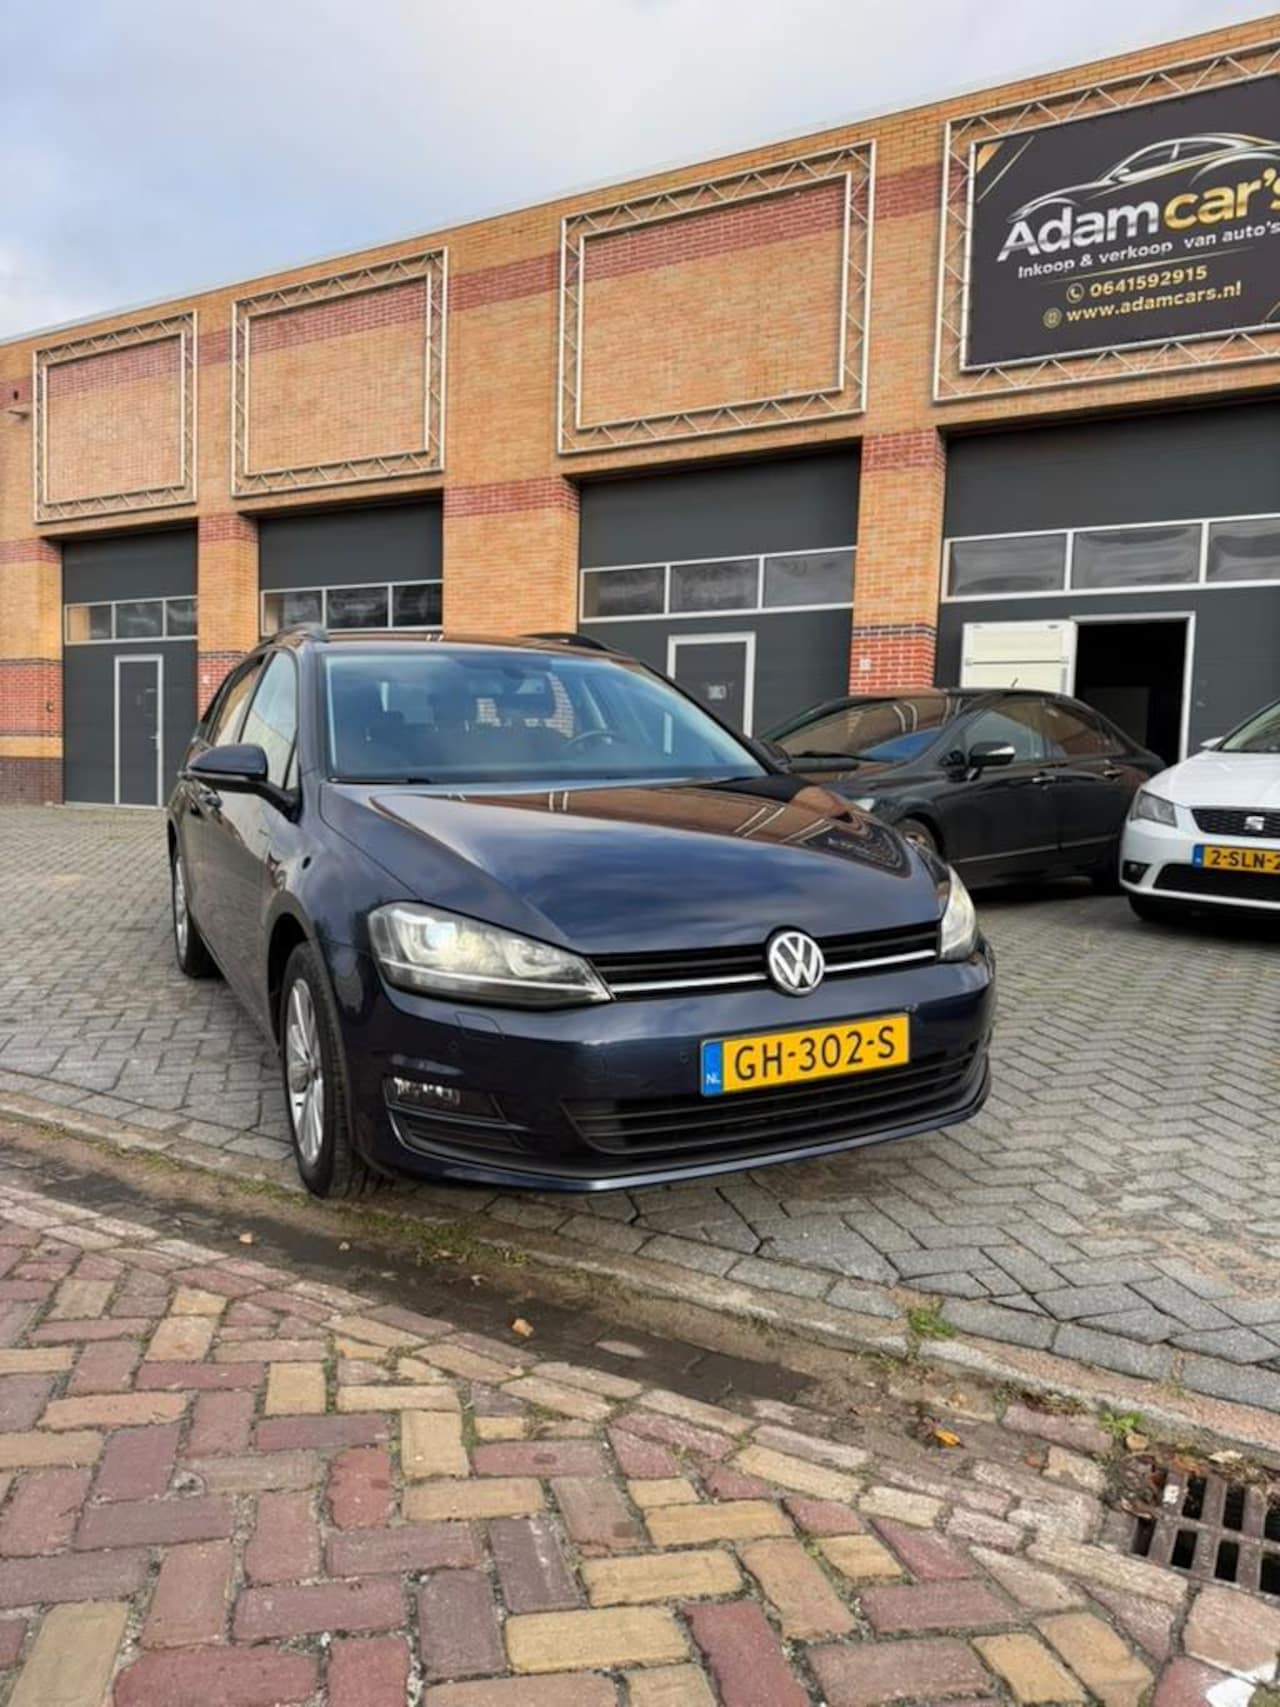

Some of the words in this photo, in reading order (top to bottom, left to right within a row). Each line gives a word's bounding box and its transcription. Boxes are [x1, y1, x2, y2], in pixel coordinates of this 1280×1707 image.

[997, 199, 1160, 262] Adam
[1017, 257, 1076, 279] Inkoop
[1079, 253, 1094, 267] &
[1098, 240, 1174, 266] verkoop
[1183, 233, 1217, 249] van
[1066, 281, 1242, 323] www.adamcars.nl
[1089, 265, 1208, 299] 0641592915
[734, 1025, 896, 1081] GH-302-S
